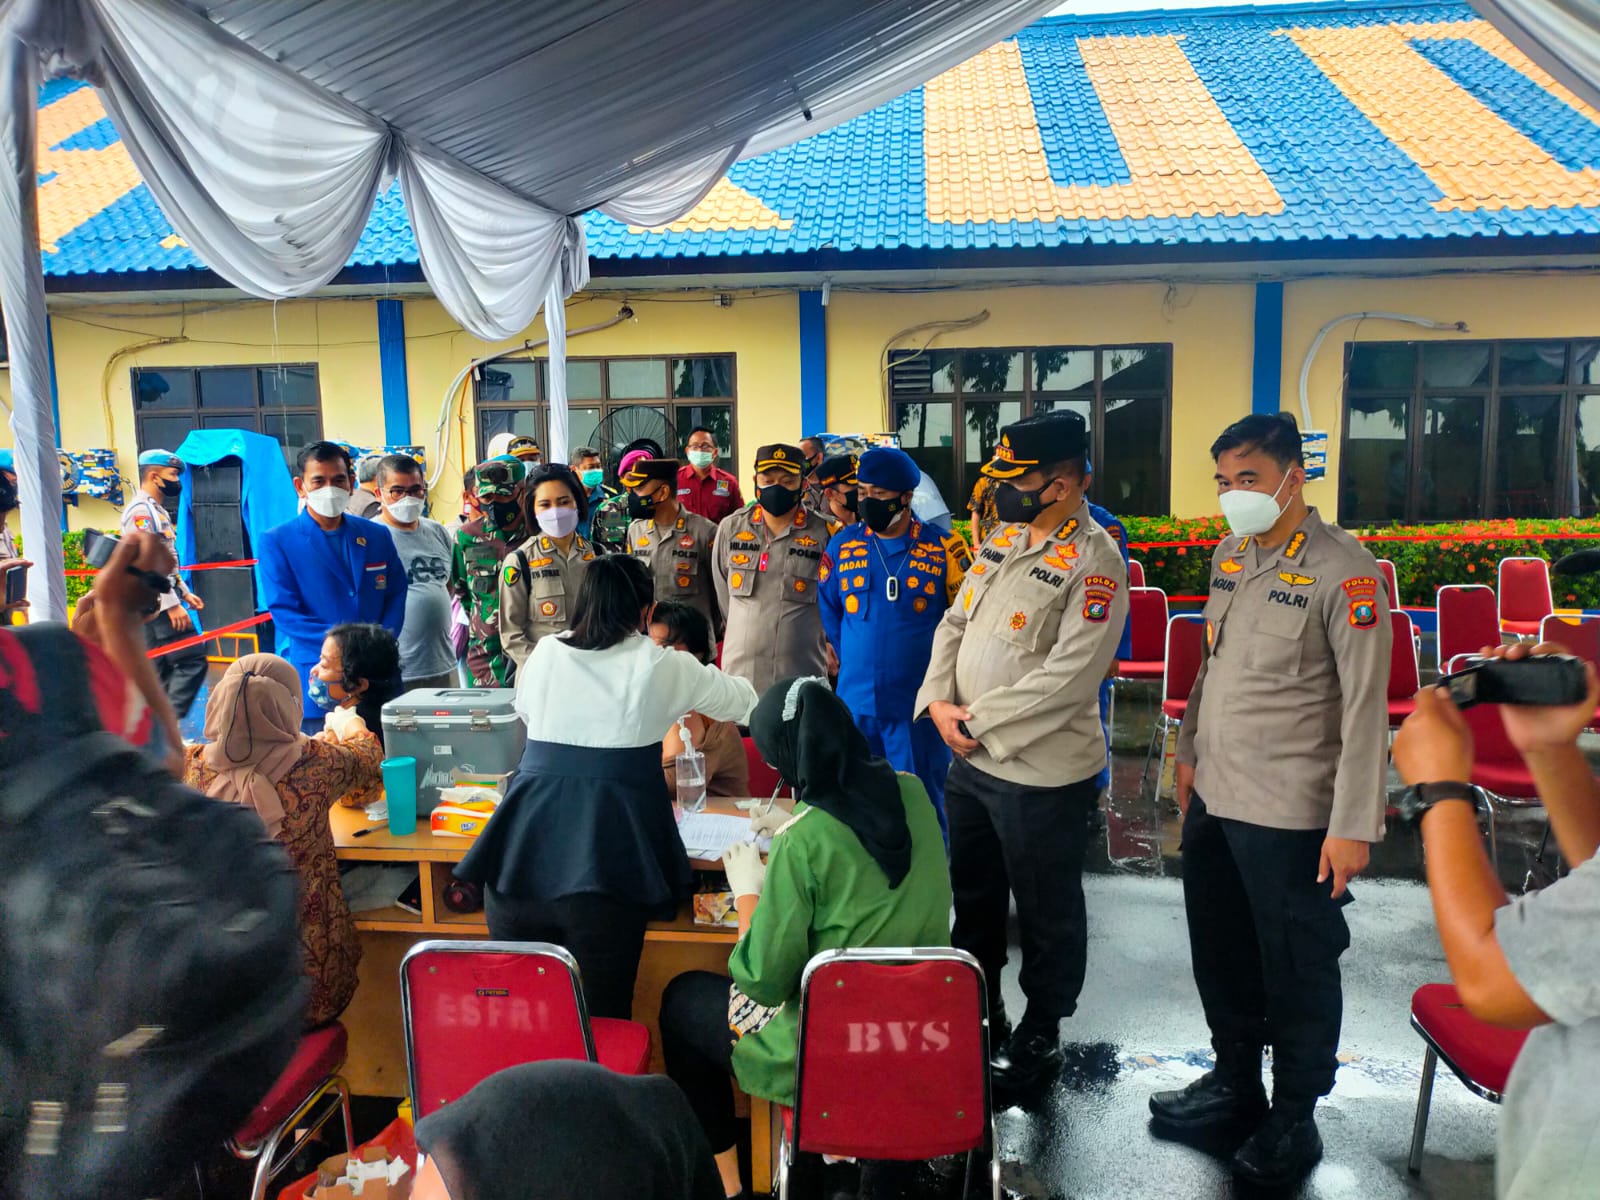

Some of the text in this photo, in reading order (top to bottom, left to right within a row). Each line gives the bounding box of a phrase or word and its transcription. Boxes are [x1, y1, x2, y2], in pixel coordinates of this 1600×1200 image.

[909, 560, 942, 576] POLRI
[1029, 567, 1065, 588] POLRI
[1086, 577, 1116, 590] POLDA
[1212, 578, 1236, 593] AGUS
[1344, 578, 1376, 590] POLDA
[1267, 590, 1309, 609] POLRI
[847, 1021, 951, 1053] BVS
